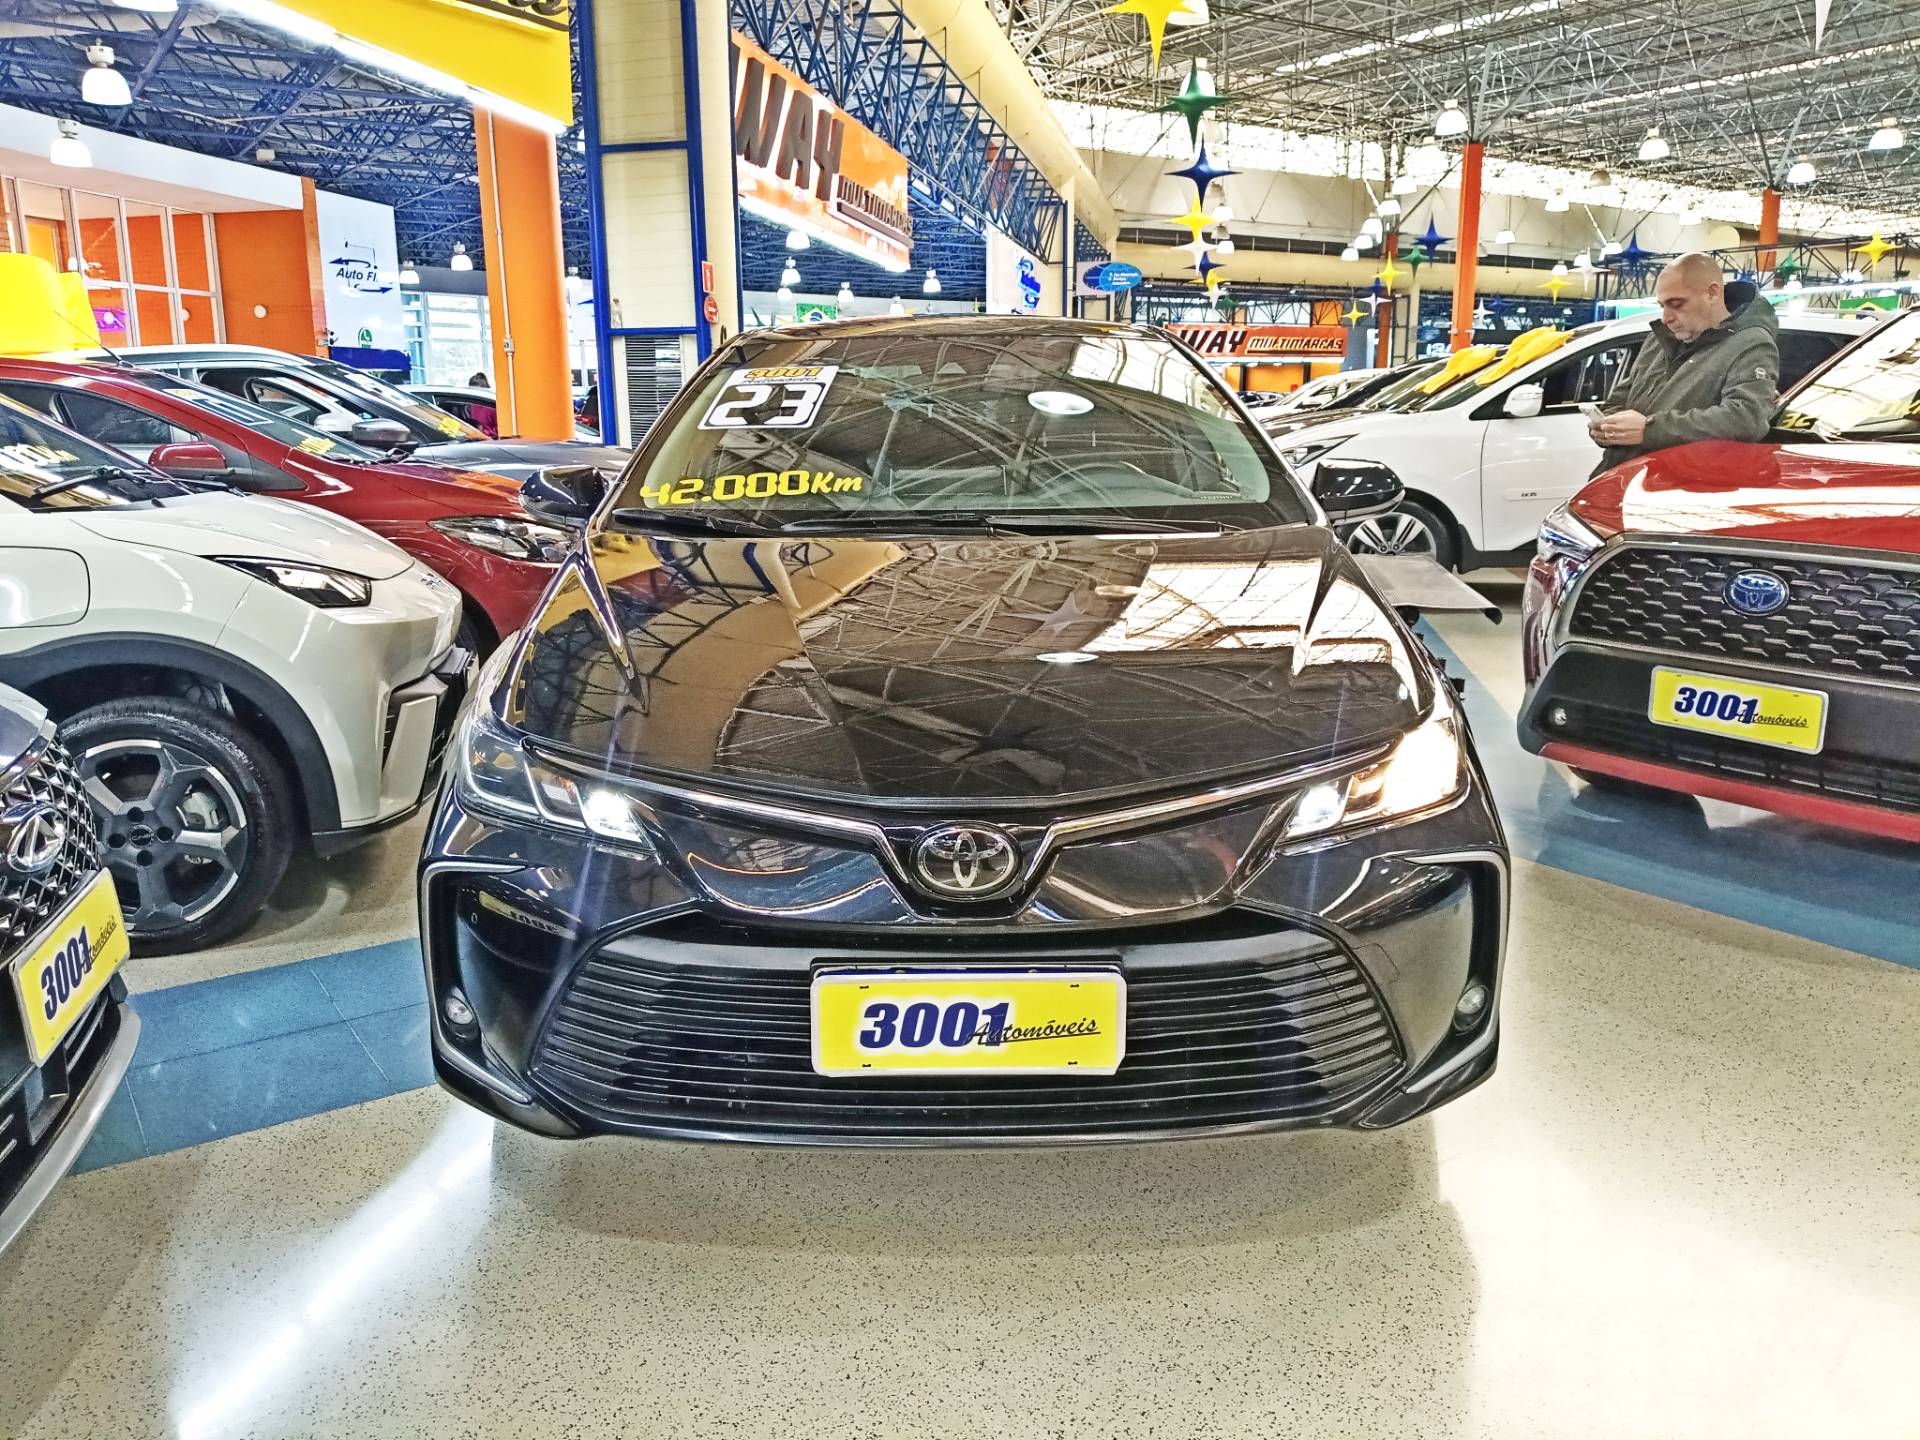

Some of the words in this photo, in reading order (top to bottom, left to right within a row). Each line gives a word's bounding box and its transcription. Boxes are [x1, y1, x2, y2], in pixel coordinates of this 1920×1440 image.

[729, 41, 845, 202] WAY
[837, 175, 914, 238] MULTIMARCAS
[336, 267, 364, 281] Auto
[1180, 329, 1248, 353] WAY
[708, 384, 823, 426] 23
[1674, 687, 1758, 725] 3001
[1737, 709, 1809, 727] Atomóveis
[41, 925, 91, 1020] 3001
[860, 1002, 1010, 1048] 3001
[965, 1018, 1101, 1045] Automóveis
